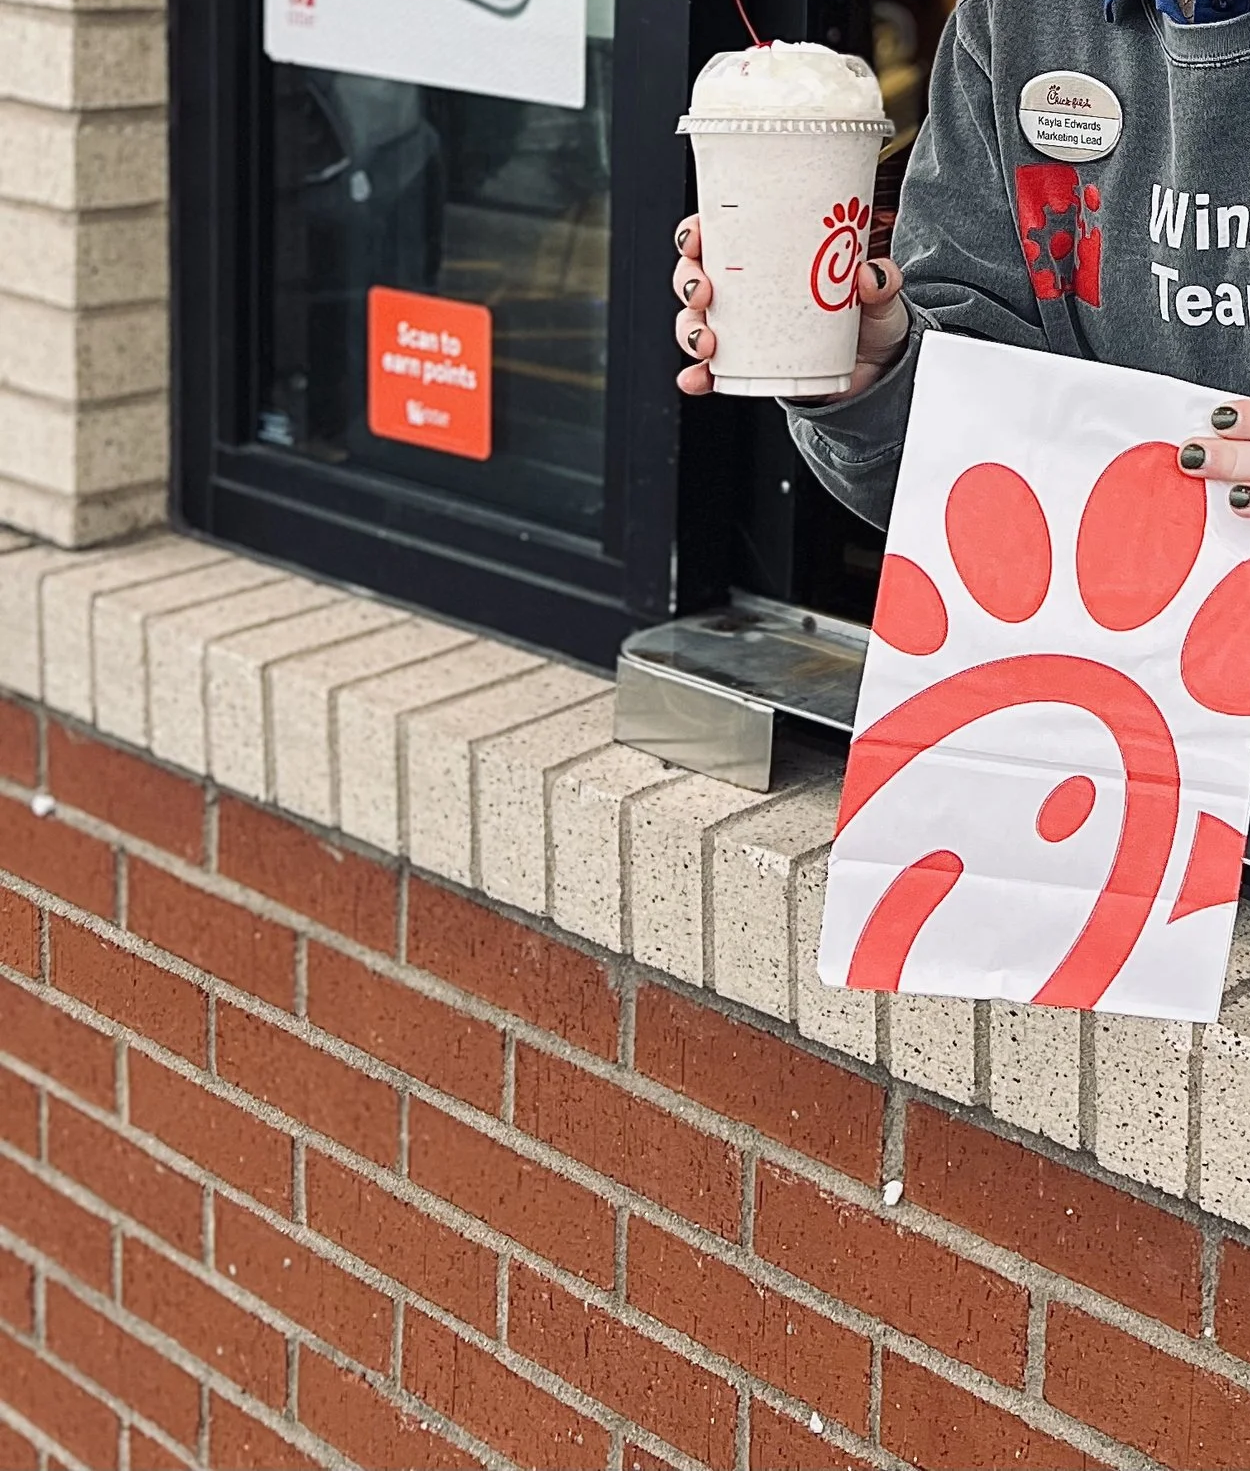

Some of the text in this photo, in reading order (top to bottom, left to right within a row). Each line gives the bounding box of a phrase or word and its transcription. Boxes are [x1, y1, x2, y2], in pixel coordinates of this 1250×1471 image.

[1038, 116, 1102, 131] Kayla Edwards
[1037, 130, 1102, 146] Marketing Lead
[397, 321, 462, 357] Scan to
[381, 352, 477, 390] earn points
